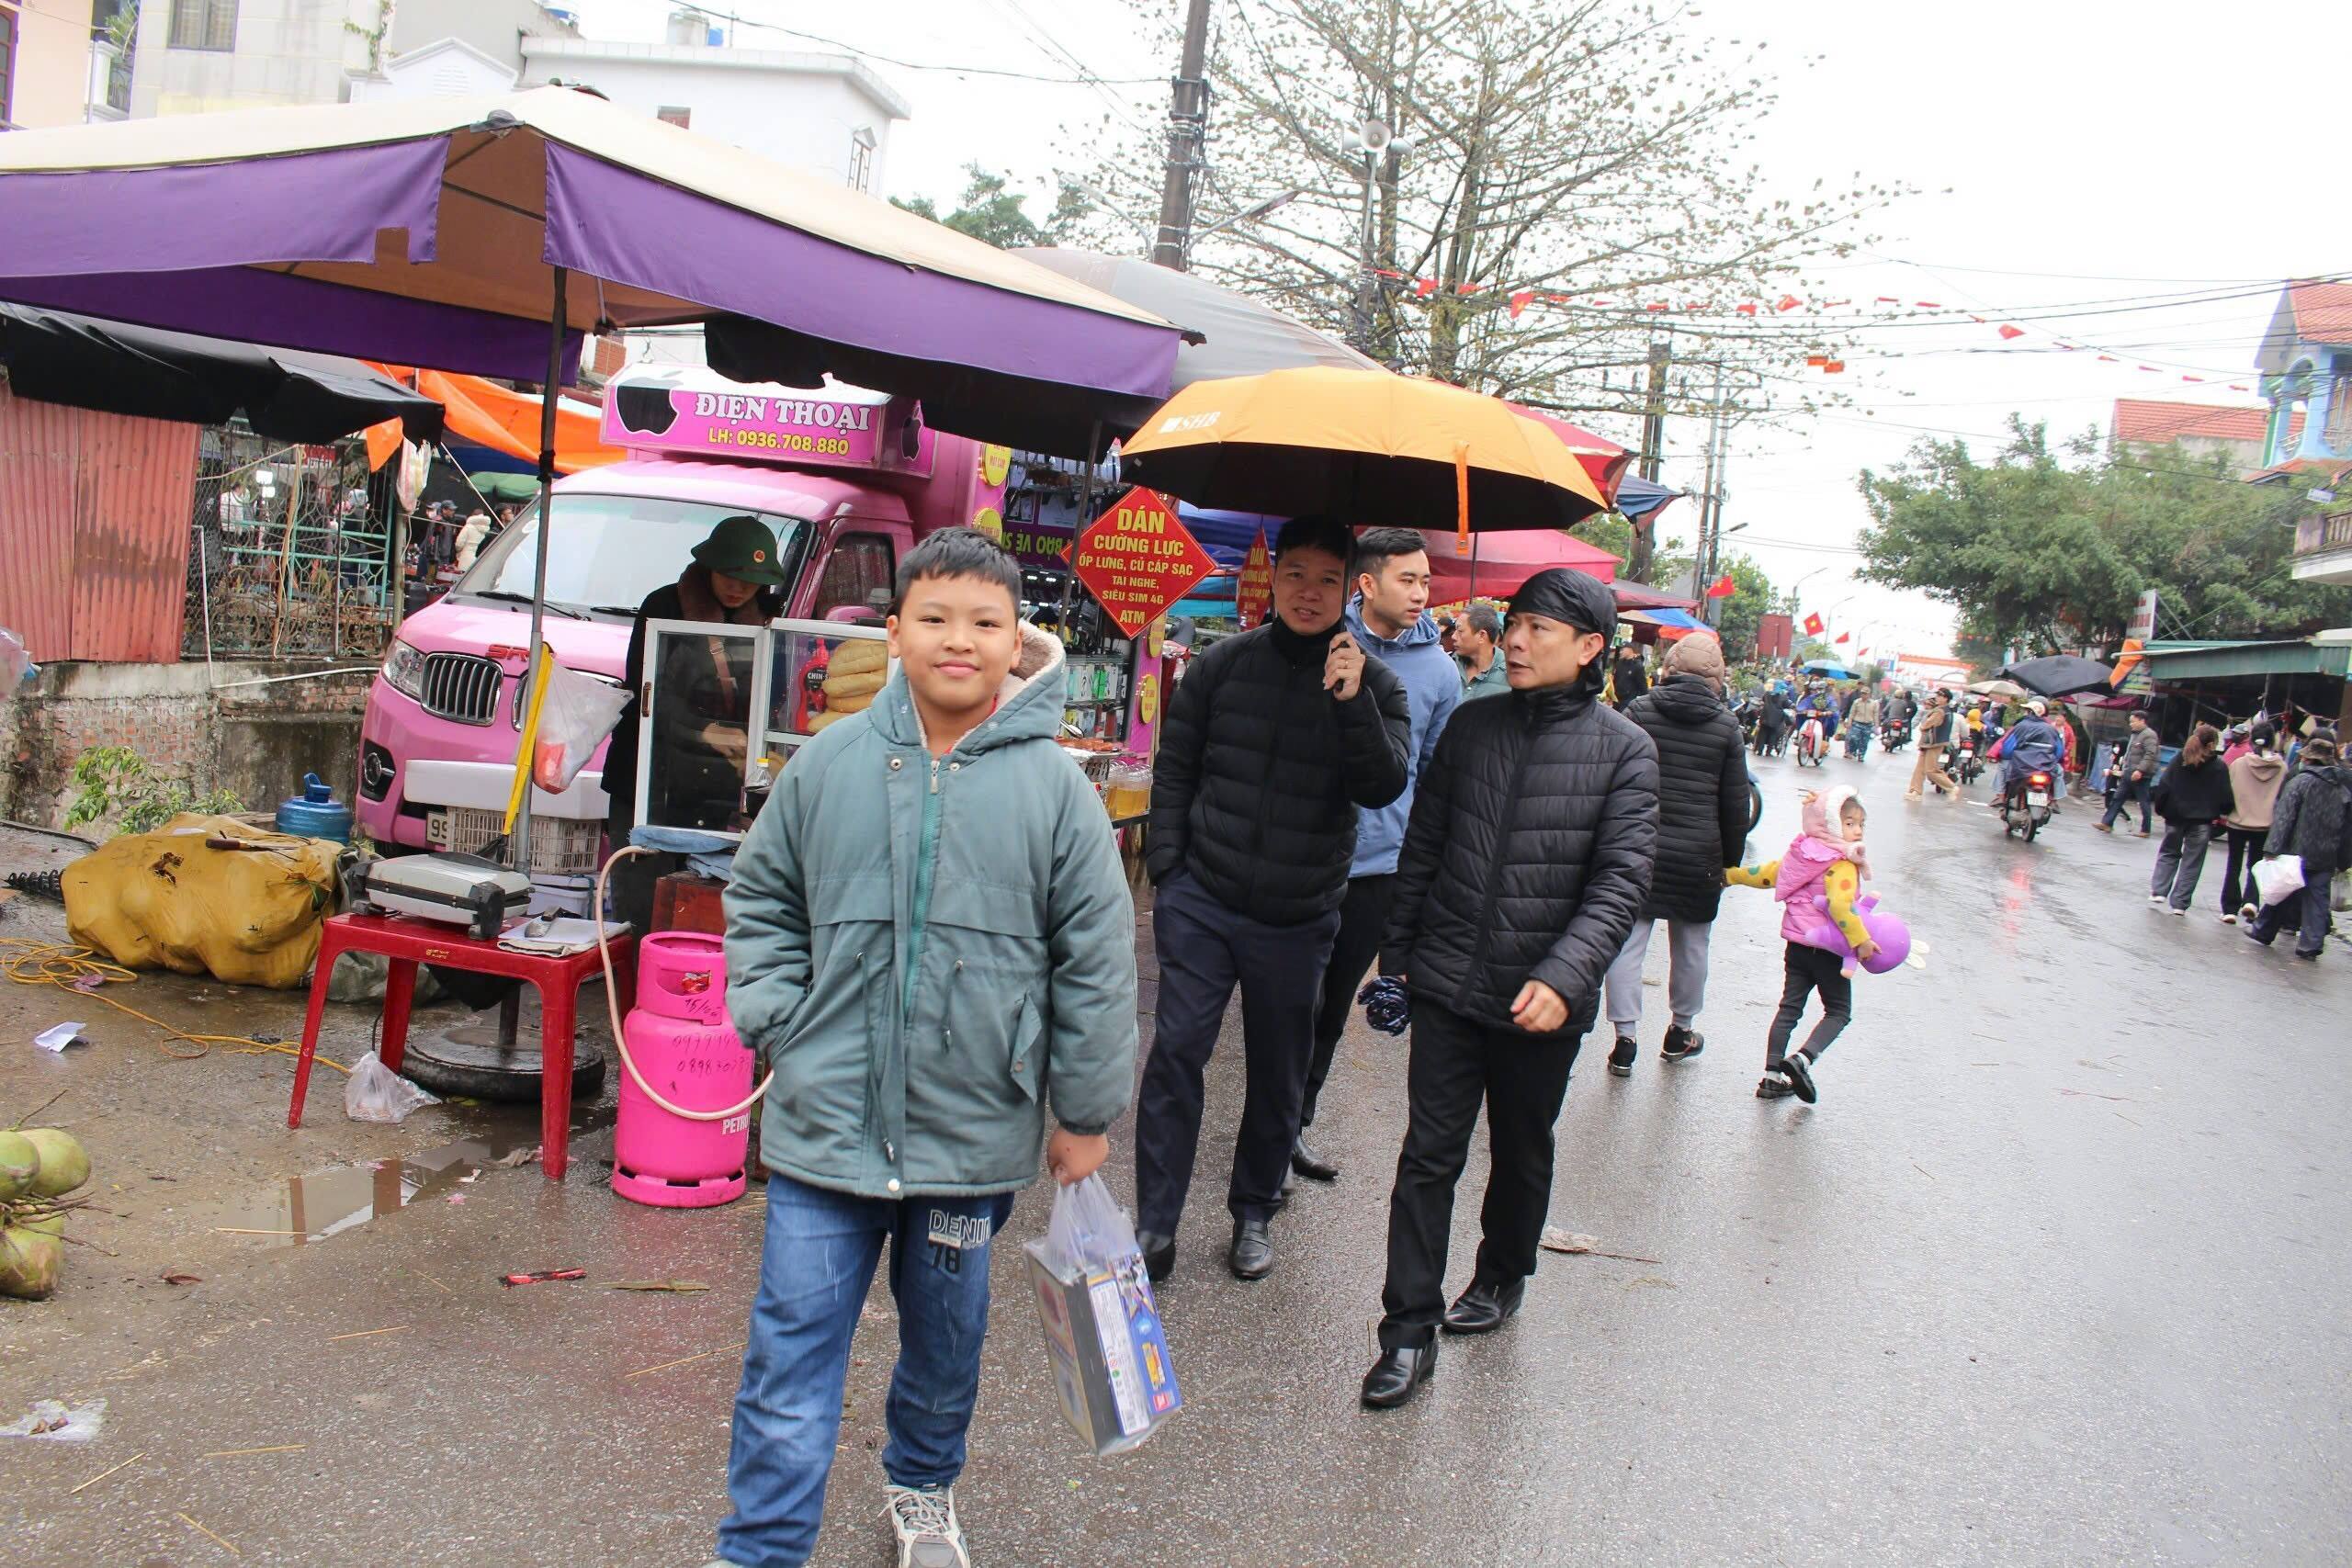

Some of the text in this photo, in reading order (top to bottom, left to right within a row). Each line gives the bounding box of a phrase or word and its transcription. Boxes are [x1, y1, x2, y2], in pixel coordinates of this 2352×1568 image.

[775, 399, 871, 435] THOẠI
[708, 427, 849, 456] LH: 0936.708.880
[1117, 505, 1165, 534] DÁN
[1093, 534, 1184, 558] CƯỜNG LỰC
[1079, 551, 1193, 579] ỐP LƯNG, CỦ CÁP SẠC
[1113, 576, 1159, 590] TAI NGHE,
[1102, 589, 1164, 604] SIÊU SIM 4G
[1120, 610, 1145, 624] ATM
[485, 645, 529, 661] SR
[431, 818, 447, 839] 99
[721, 1112, 749, 1135] PETRO
